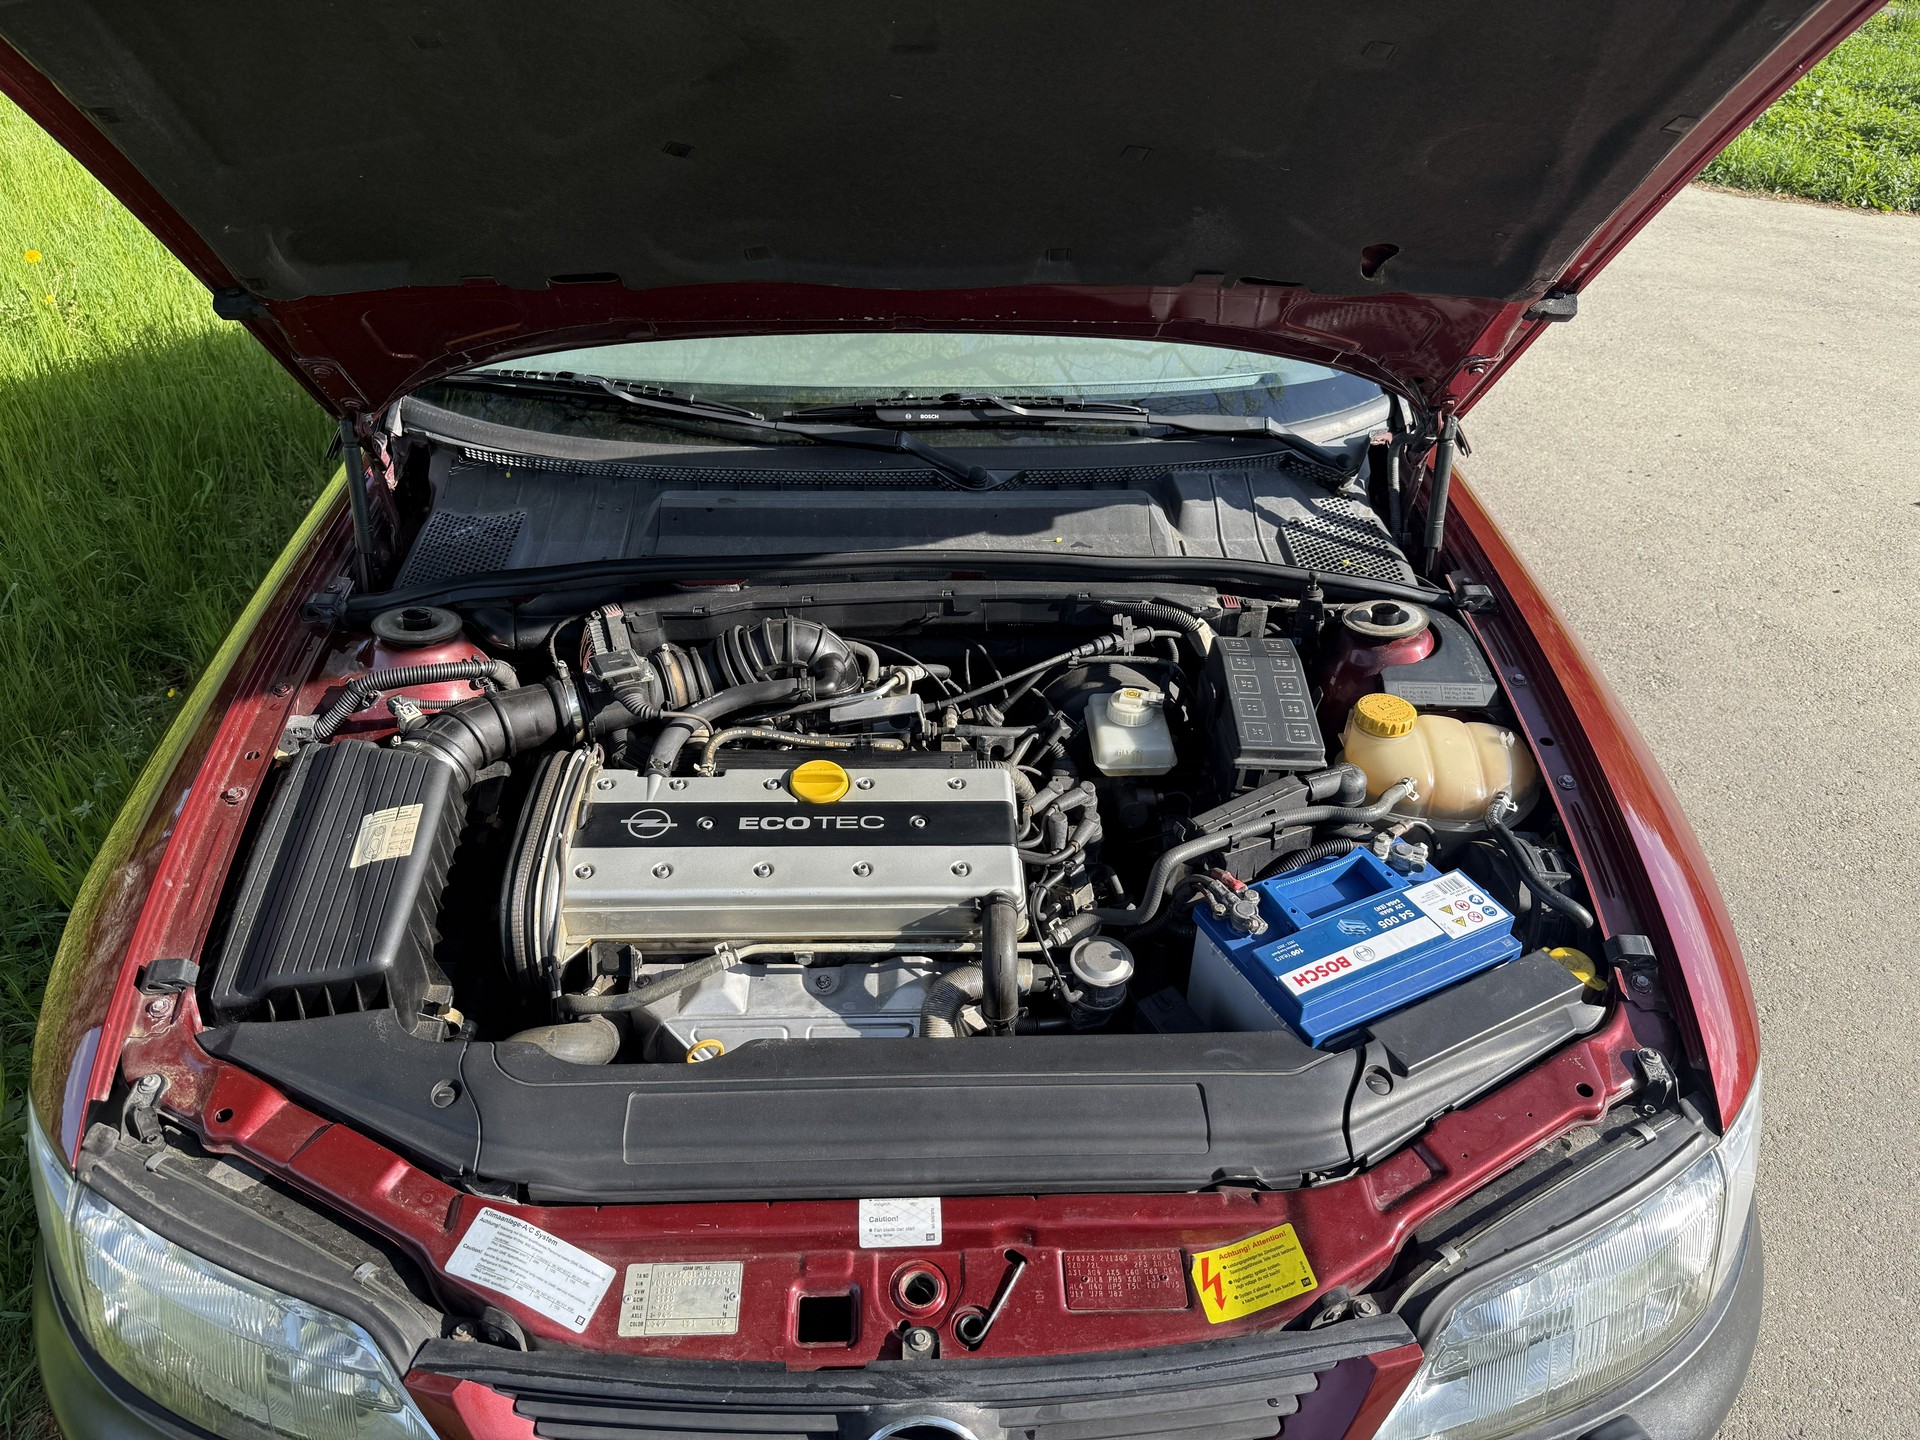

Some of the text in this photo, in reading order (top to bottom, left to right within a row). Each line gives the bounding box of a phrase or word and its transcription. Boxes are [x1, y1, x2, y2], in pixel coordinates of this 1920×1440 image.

[738, 815, 885, 830] ECOTEC
[1378, 909, 1416, 929] S4 005
[1292, 956, 1352, 987] BOSCH
[479, 1217, 501, 1229] Achtung!
[868, 1215, 899, 1223] Caution!
[534, 1230, 558, 1247] System
[1218, 1230, 1287, 1260] Achtung! Attention!
[462, 1243, 483, 1255] Caution!
